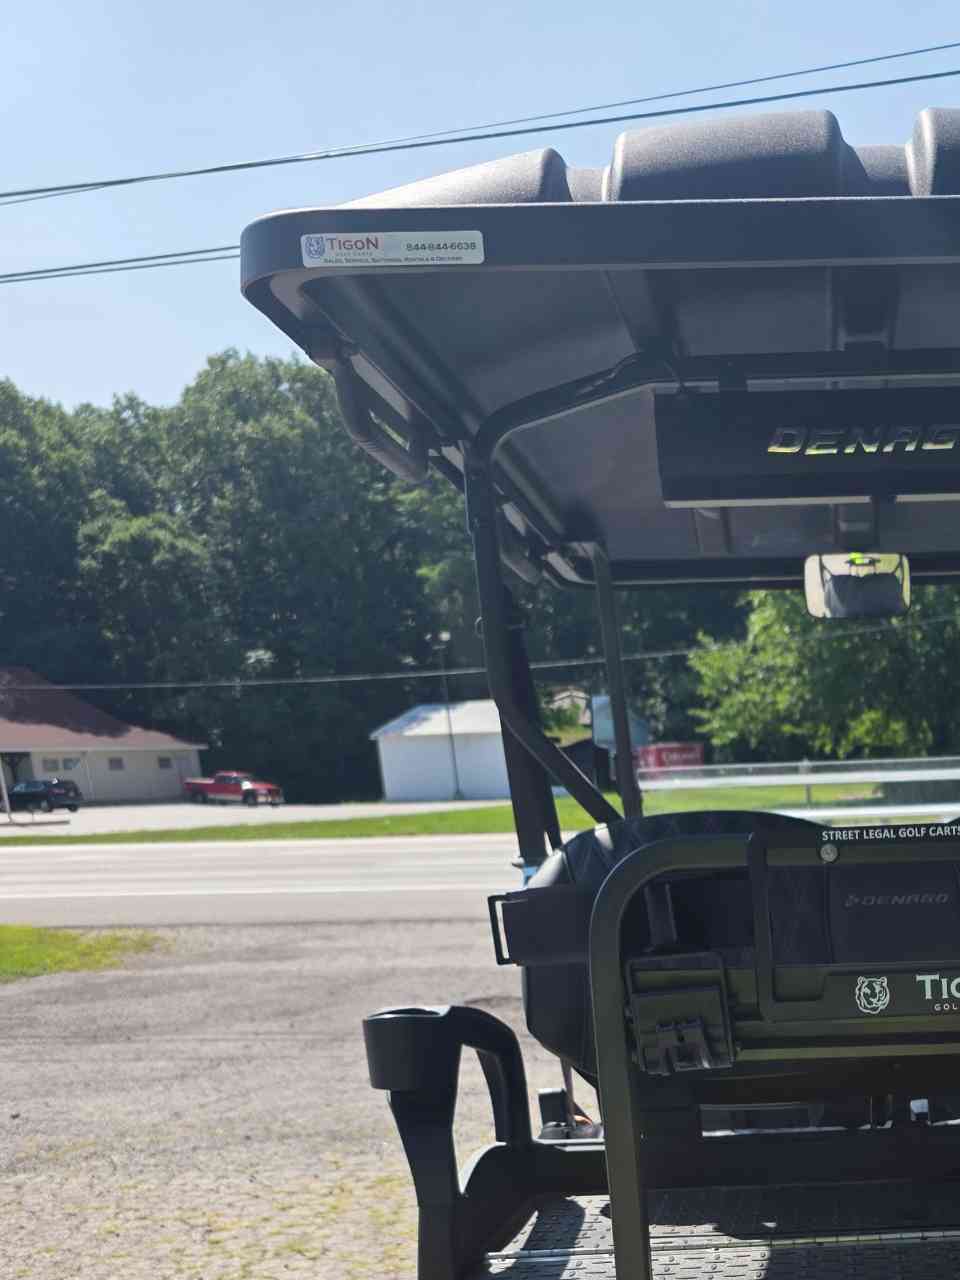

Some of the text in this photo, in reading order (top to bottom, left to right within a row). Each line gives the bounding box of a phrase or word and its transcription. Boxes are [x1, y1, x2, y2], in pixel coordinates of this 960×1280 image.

[327, 237, 379, 251] TIGON
[822, 830, 859, 841] STREET
[863, 828, 896, 840] LEGAL
[899, 827, 926, 838] GOLF
